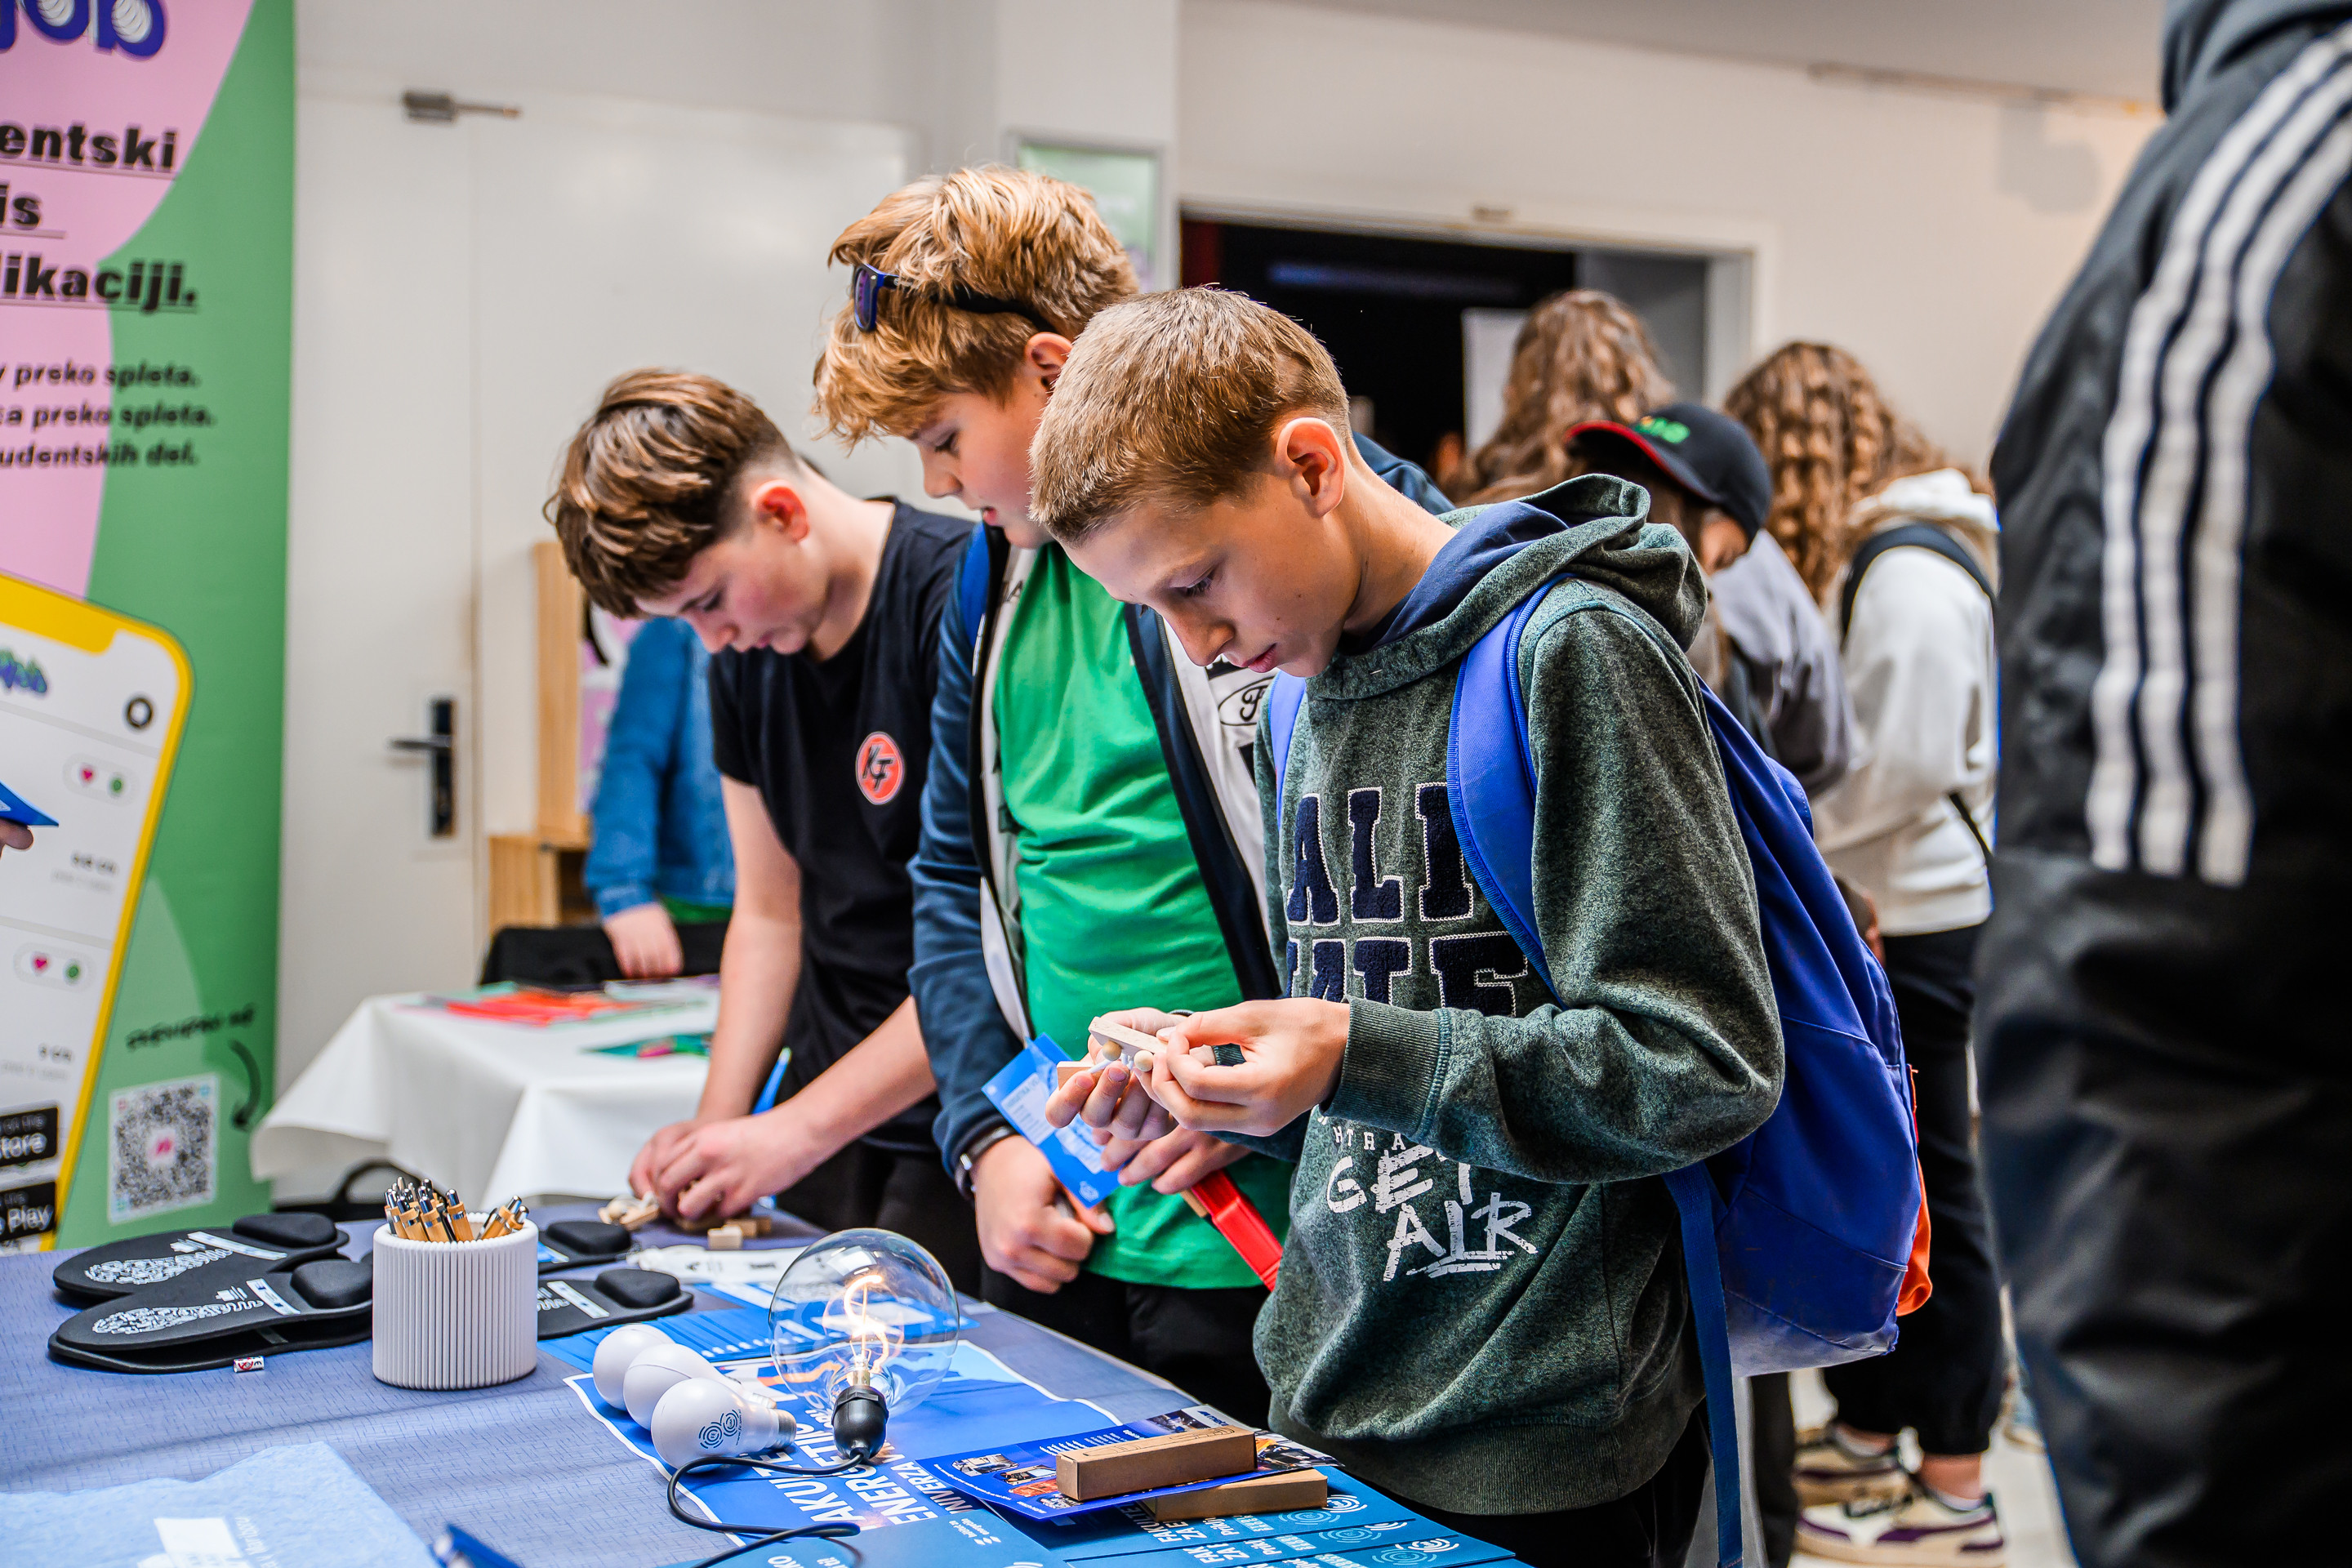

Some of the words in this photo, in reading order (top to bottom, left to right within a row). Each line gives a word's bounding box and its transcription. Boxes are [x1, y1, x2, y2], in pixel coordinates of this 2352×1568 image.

[0, 122, 177, 171] entski
[0, 254, 197, 312] ikaciji.
[0, 1133, 47, 1159] tore
[1176, 1527, 1207, 1540] ZA
